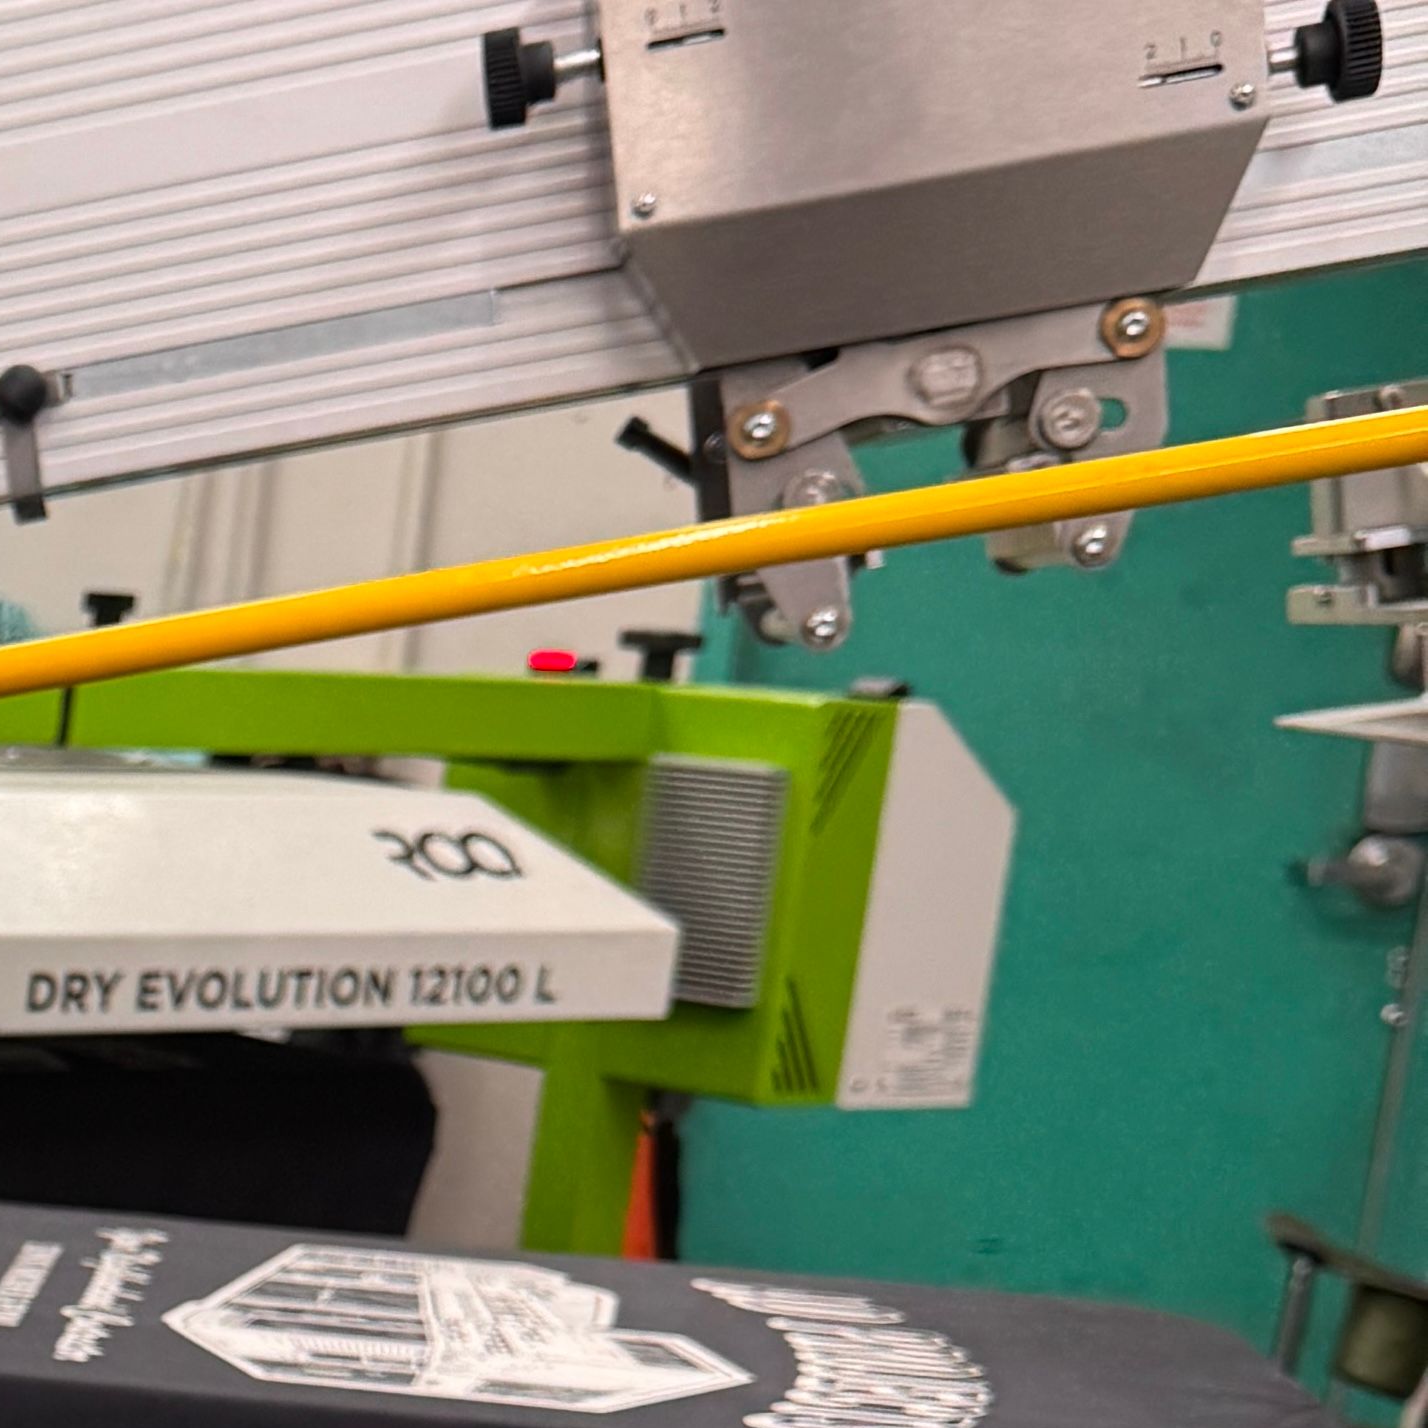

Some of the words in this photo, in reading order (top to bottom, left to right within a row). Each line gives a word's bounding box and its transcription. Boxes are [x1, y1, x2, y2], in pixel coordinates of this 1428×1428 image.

[1145, 43, 1156, 60] 2
[1210, 30, 1223, 47] 0
[372, 827, 525, 883] ROQ
[25, 968, 127, 1015] DRY
[134, 966, 398, 1012] EVOLUTION
[408, 962, 522, 1008] 12100
[535, 963, 557, 1006] L
